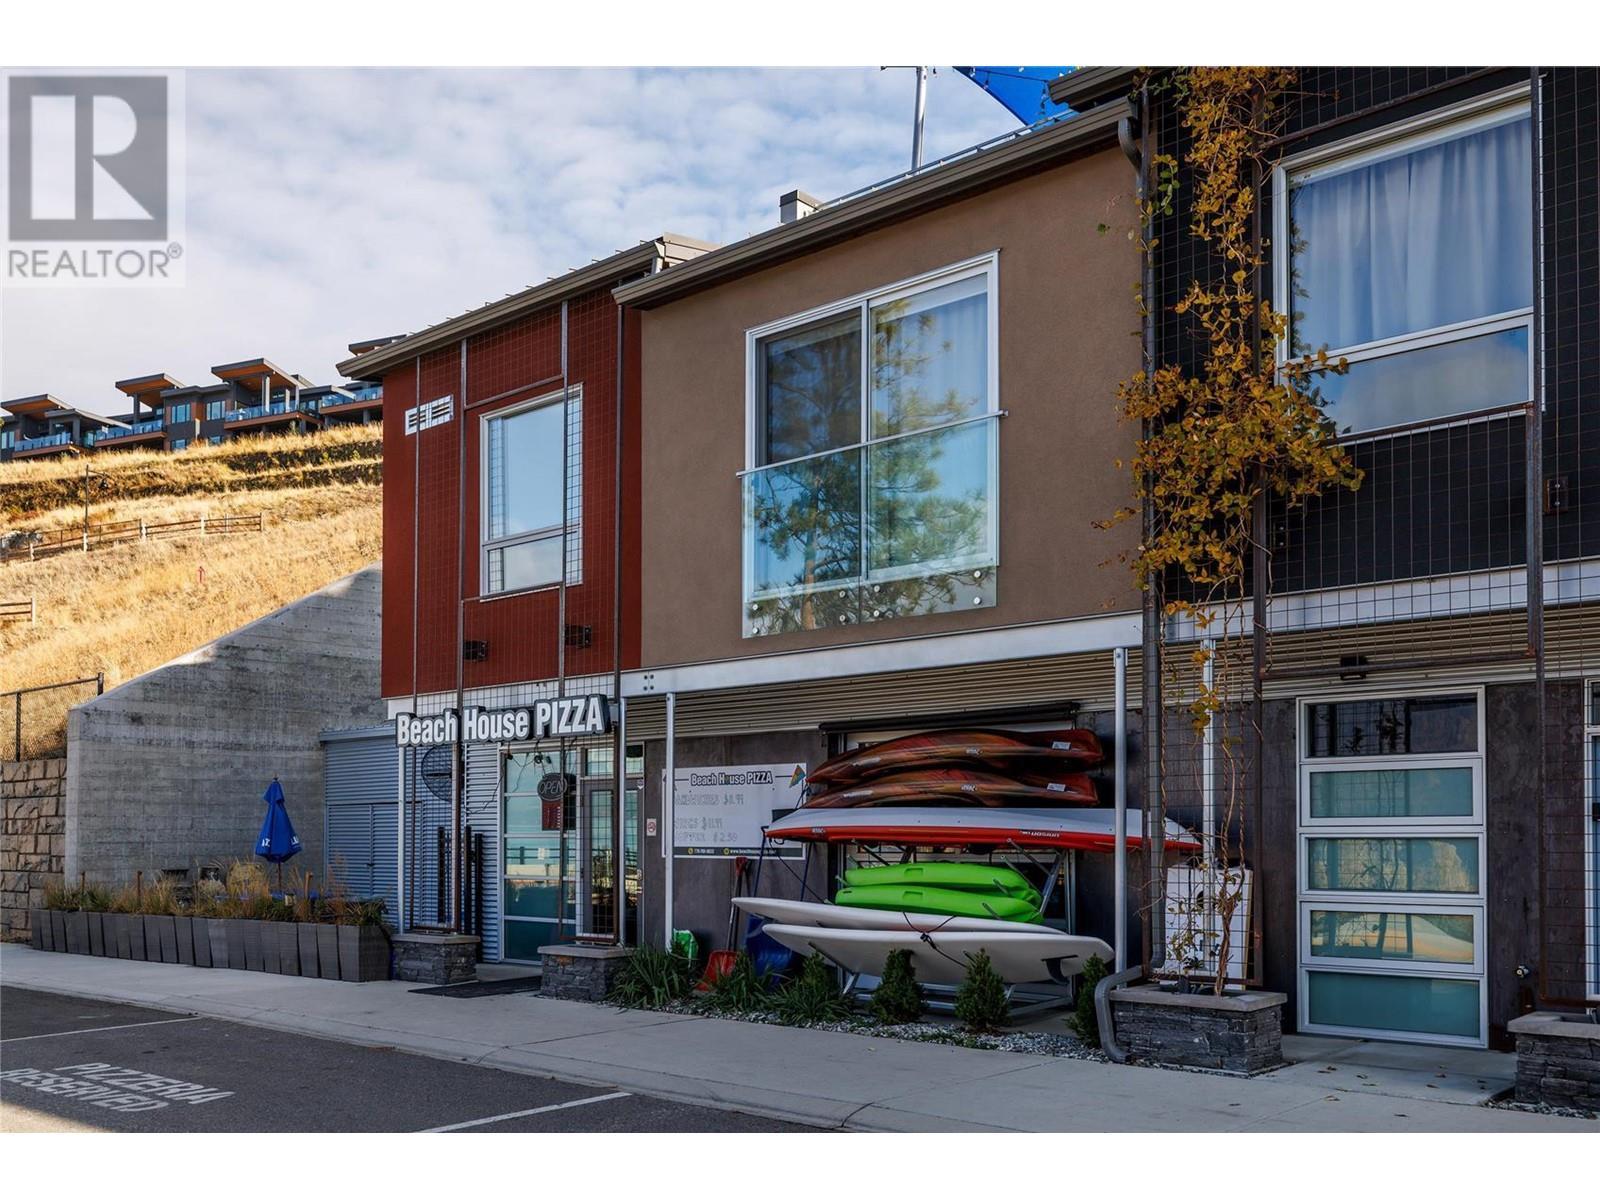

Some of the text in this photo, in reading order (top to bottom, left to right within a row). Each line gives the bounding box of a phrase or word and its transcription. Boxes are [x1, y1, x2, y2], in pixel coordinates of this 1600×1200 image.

[397, 696, 604, 746] Beach House PIZZA
[538, 779, 566, 796] OPEN
[690, 773, 717, 786] Beach
[746, 771, 774, 785] PIZZA
[0, 1067, 169, 1112] RESERVED
[54, 1062, 236, 1105] PIZZERIA
